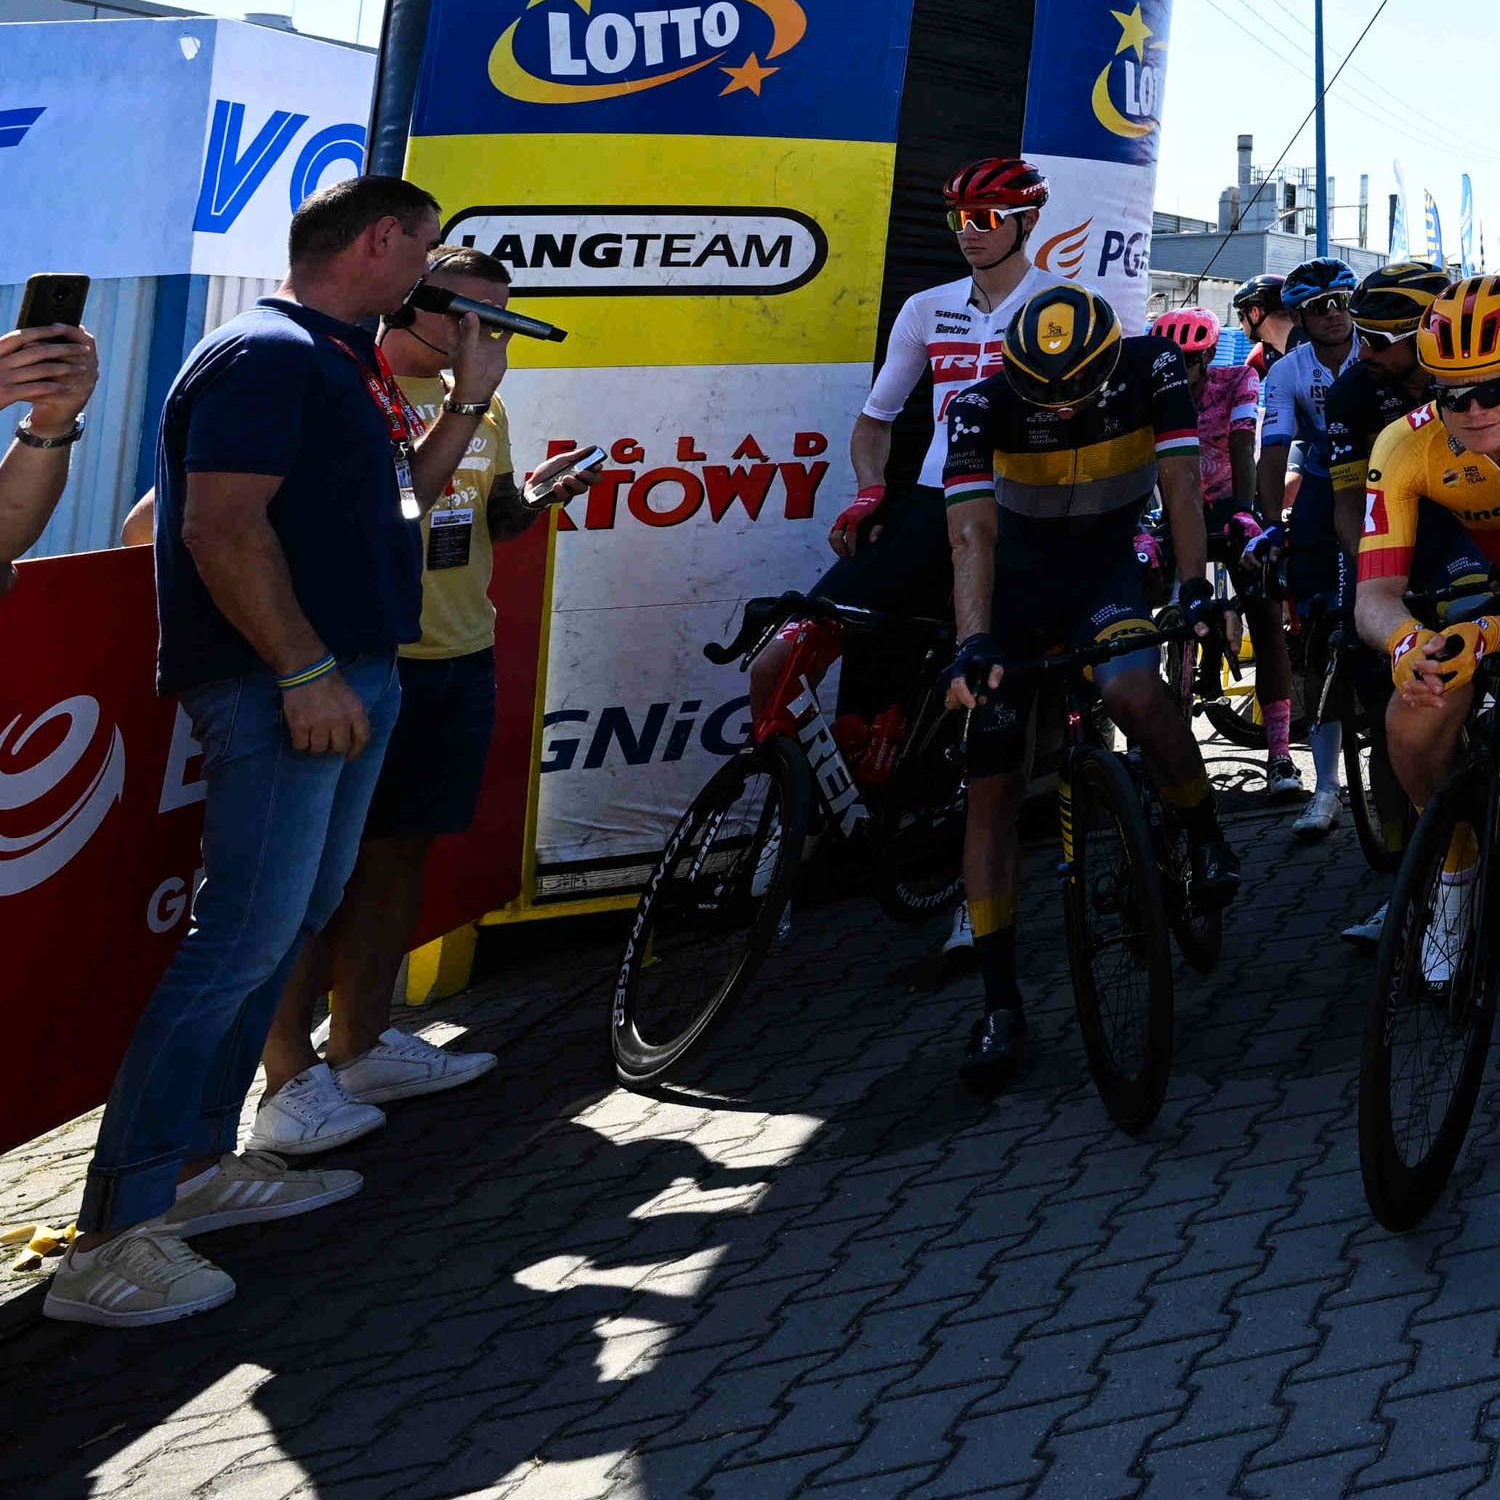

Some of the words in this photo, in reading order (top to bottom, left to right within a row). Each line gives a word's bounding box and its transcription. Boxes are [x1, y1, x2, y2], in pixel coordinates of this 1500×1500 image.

[548, 2, 741, 77] LOTTO
[935, 309, 971, 322] SRAM
[935, 323, 970, 335] Santini
[929, 351, 1004, 369] TRE
[785, 674, 873, 839] TREK
